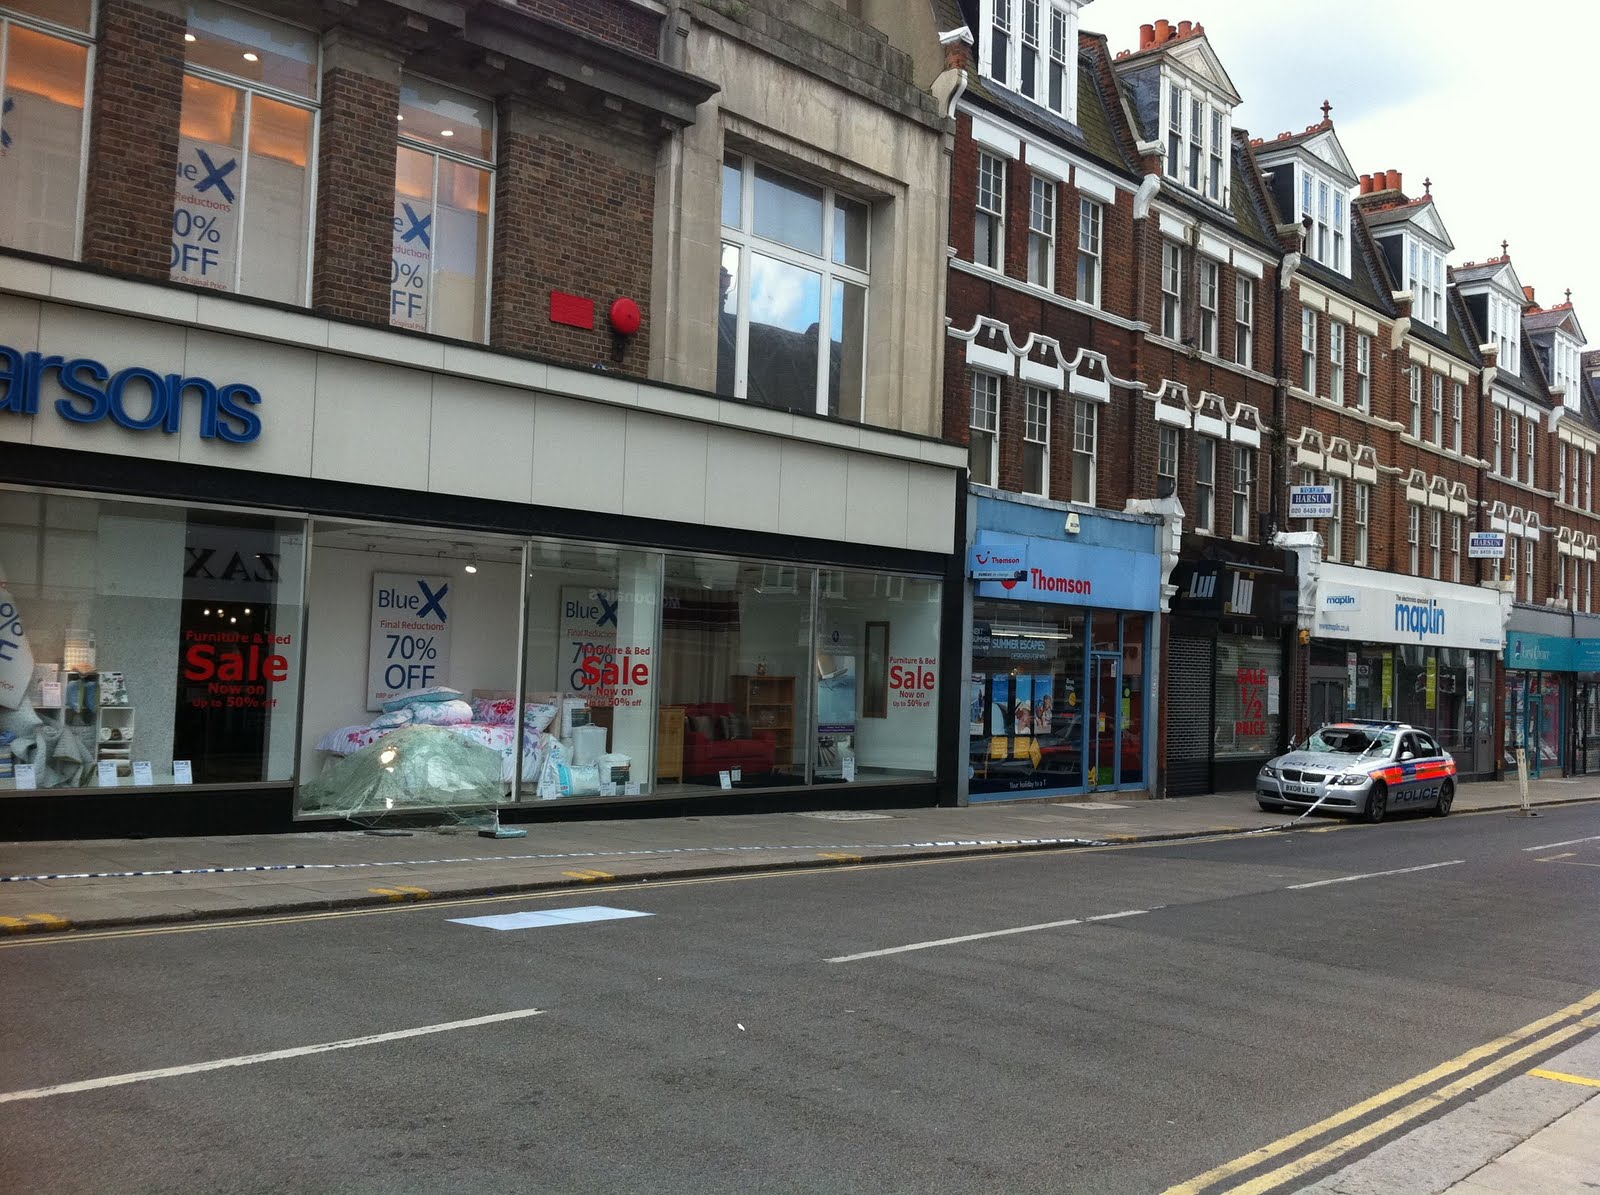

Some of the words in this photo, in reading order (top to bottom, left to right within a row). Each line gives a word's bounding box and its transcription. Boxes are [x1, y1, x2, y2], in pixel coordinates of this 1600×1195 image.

[0, 345, 262, 443] arsons
[1295, 494, 1328, 503] HARSUN
[1031, 568, 1091, 595] Thomson
[1326, 595, 1355, 605] maplin
[380, 621, 400, 629] Final
[401, 622, 445, 631] Reductions
[1394, 599, 1445, 640] maplin
[185, 631, 249, 642] Furniture
[386, 634, 437, 661] 70%
[625, 647, 632, 655] &
[634, 646, 650, 655] Bed
[992, 638, 1020, 650] SUMMER
[1020, 639, 1046, 651] ESCAPES
[184, 643, 289, 683] Sale
[889, 656, 918, 665] Furniture
[925, 657, 936, 665] Bed
[384, 664, 436, 690] OFF
[581, 656, 649, 686] Sale
[890, 665, 935, 690] Sale
[1237, 668, 1267, 686] SALE
[208, 683, 241, 694] Now
[246, 685, 265, 695] on
[596, 687, 618, 696] Now
[621, 688, 634, 696] on
[899, 690, 915, 698] Now
[192, 697, 206, 709] Up
[227, 696, 259, 708] 50%
[609, 697, 630, 707] 50%
[631, 699, 642, 707] off
[892, 700, 899, 708] Up
[907, 699, 922, 707] 50%
[1236, 720, 1266, 736] PRICE
[1283, 761, 1336, 771] POLICE
[1395, 787, 1439, 803] POLICE
